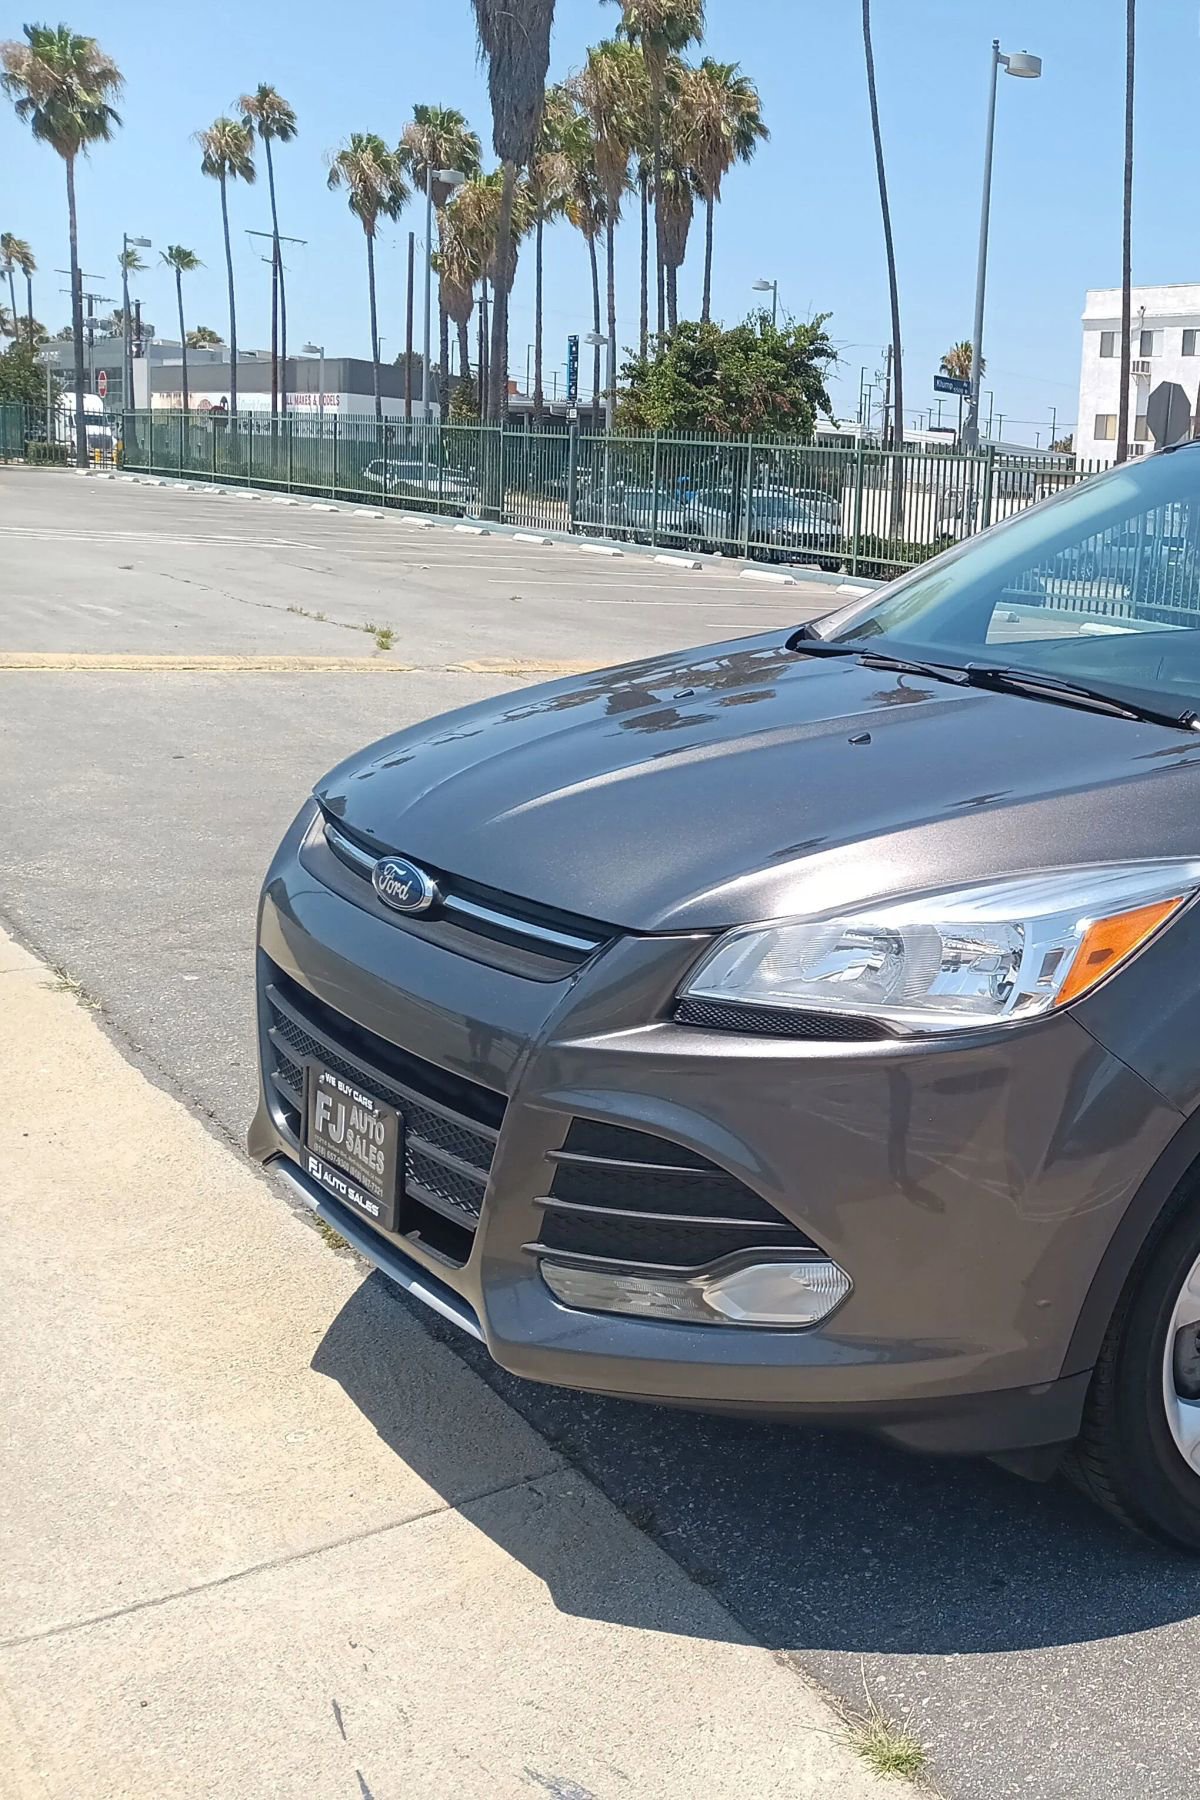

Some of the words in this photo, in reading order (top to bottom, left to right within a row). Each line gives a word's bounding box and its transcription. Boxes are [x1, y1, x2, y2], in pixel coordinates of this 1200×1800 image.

[295, 394, 311, 405] MAKES
[312, 395, 318, 405] &
[379, 863, 412, 900] Ford
[324, 1072, 337, 1087] WE
[337, 1080, 353, 1097] BUY
[352, 1090, 374, 1110] CARS
[315, 1090, 345, 1143] FJ
[349, 1105, 385, 1145] AUTO
[346, 1128, 385, 1175] SALES
[308, 1156, 322, 1180] FJ
[323, 1171, 347, 1194] AUTO
[347, 1187, 379, 1217] SALES
